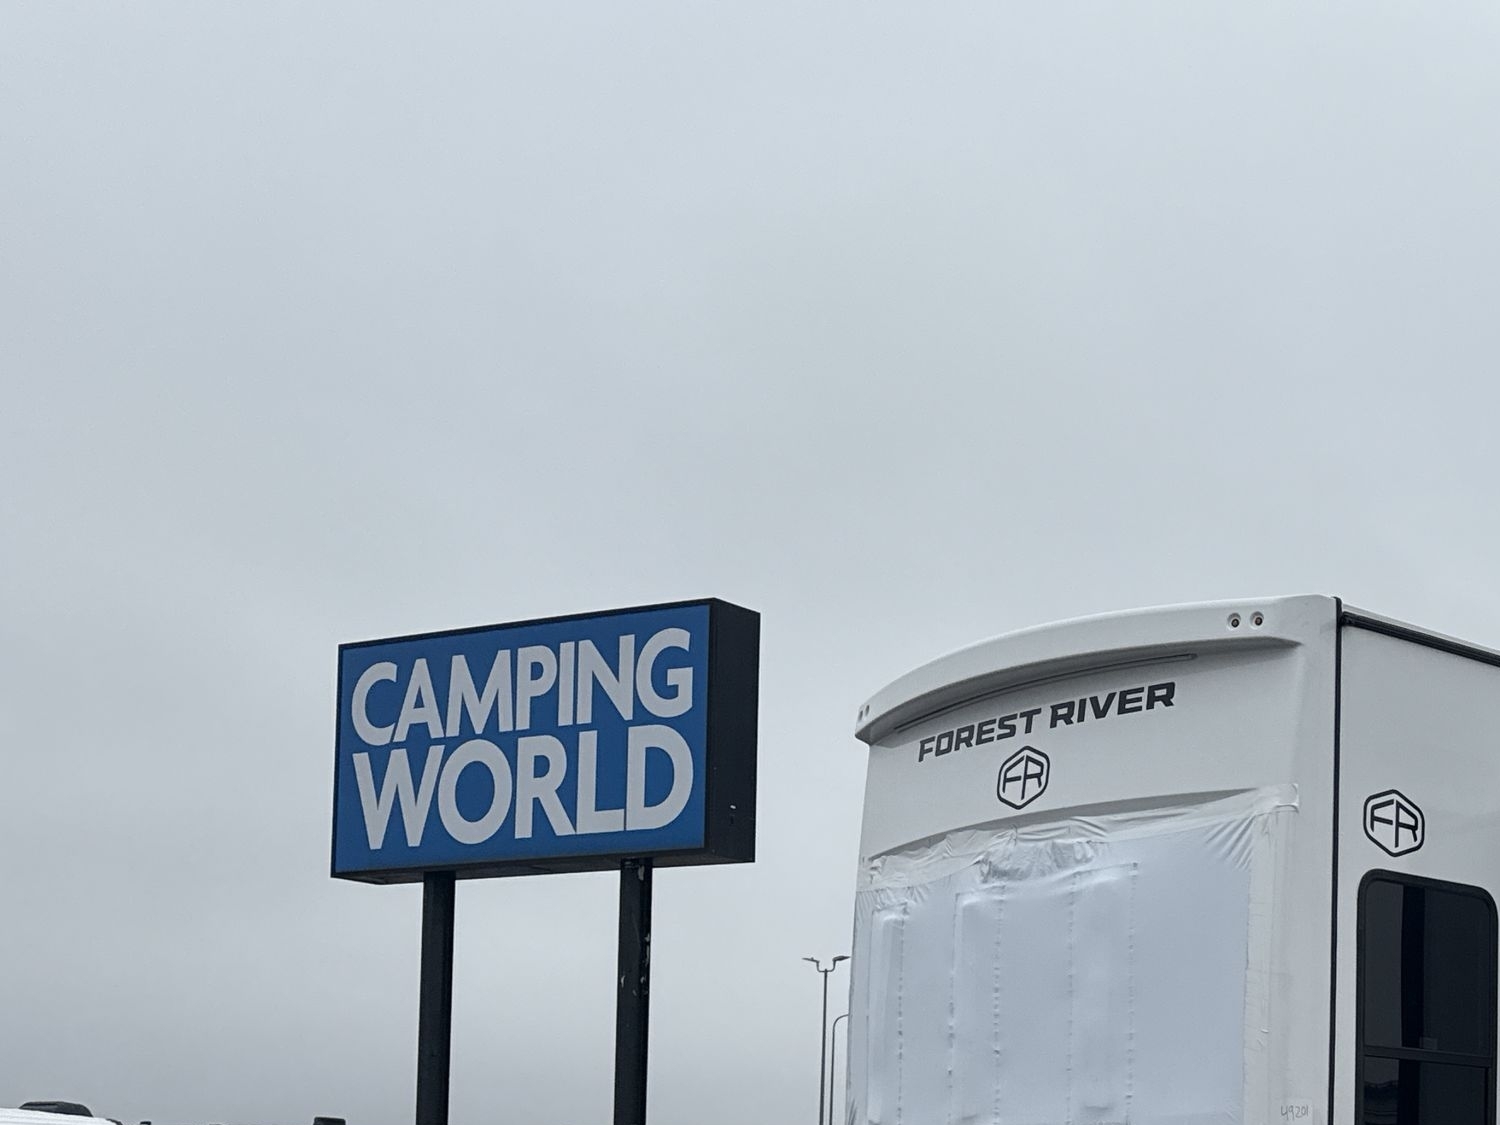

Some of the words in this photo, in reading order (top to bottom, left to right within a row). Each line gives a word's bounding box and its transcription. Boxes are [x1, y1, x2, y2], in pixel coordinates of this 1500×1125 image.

[351, 627, 694, 746] CAMPING
[918, 707, 1042, 762] FOREST
[1049, 681, 1175, 729] RIVER
[352, 724, 694, 850] WORLD
